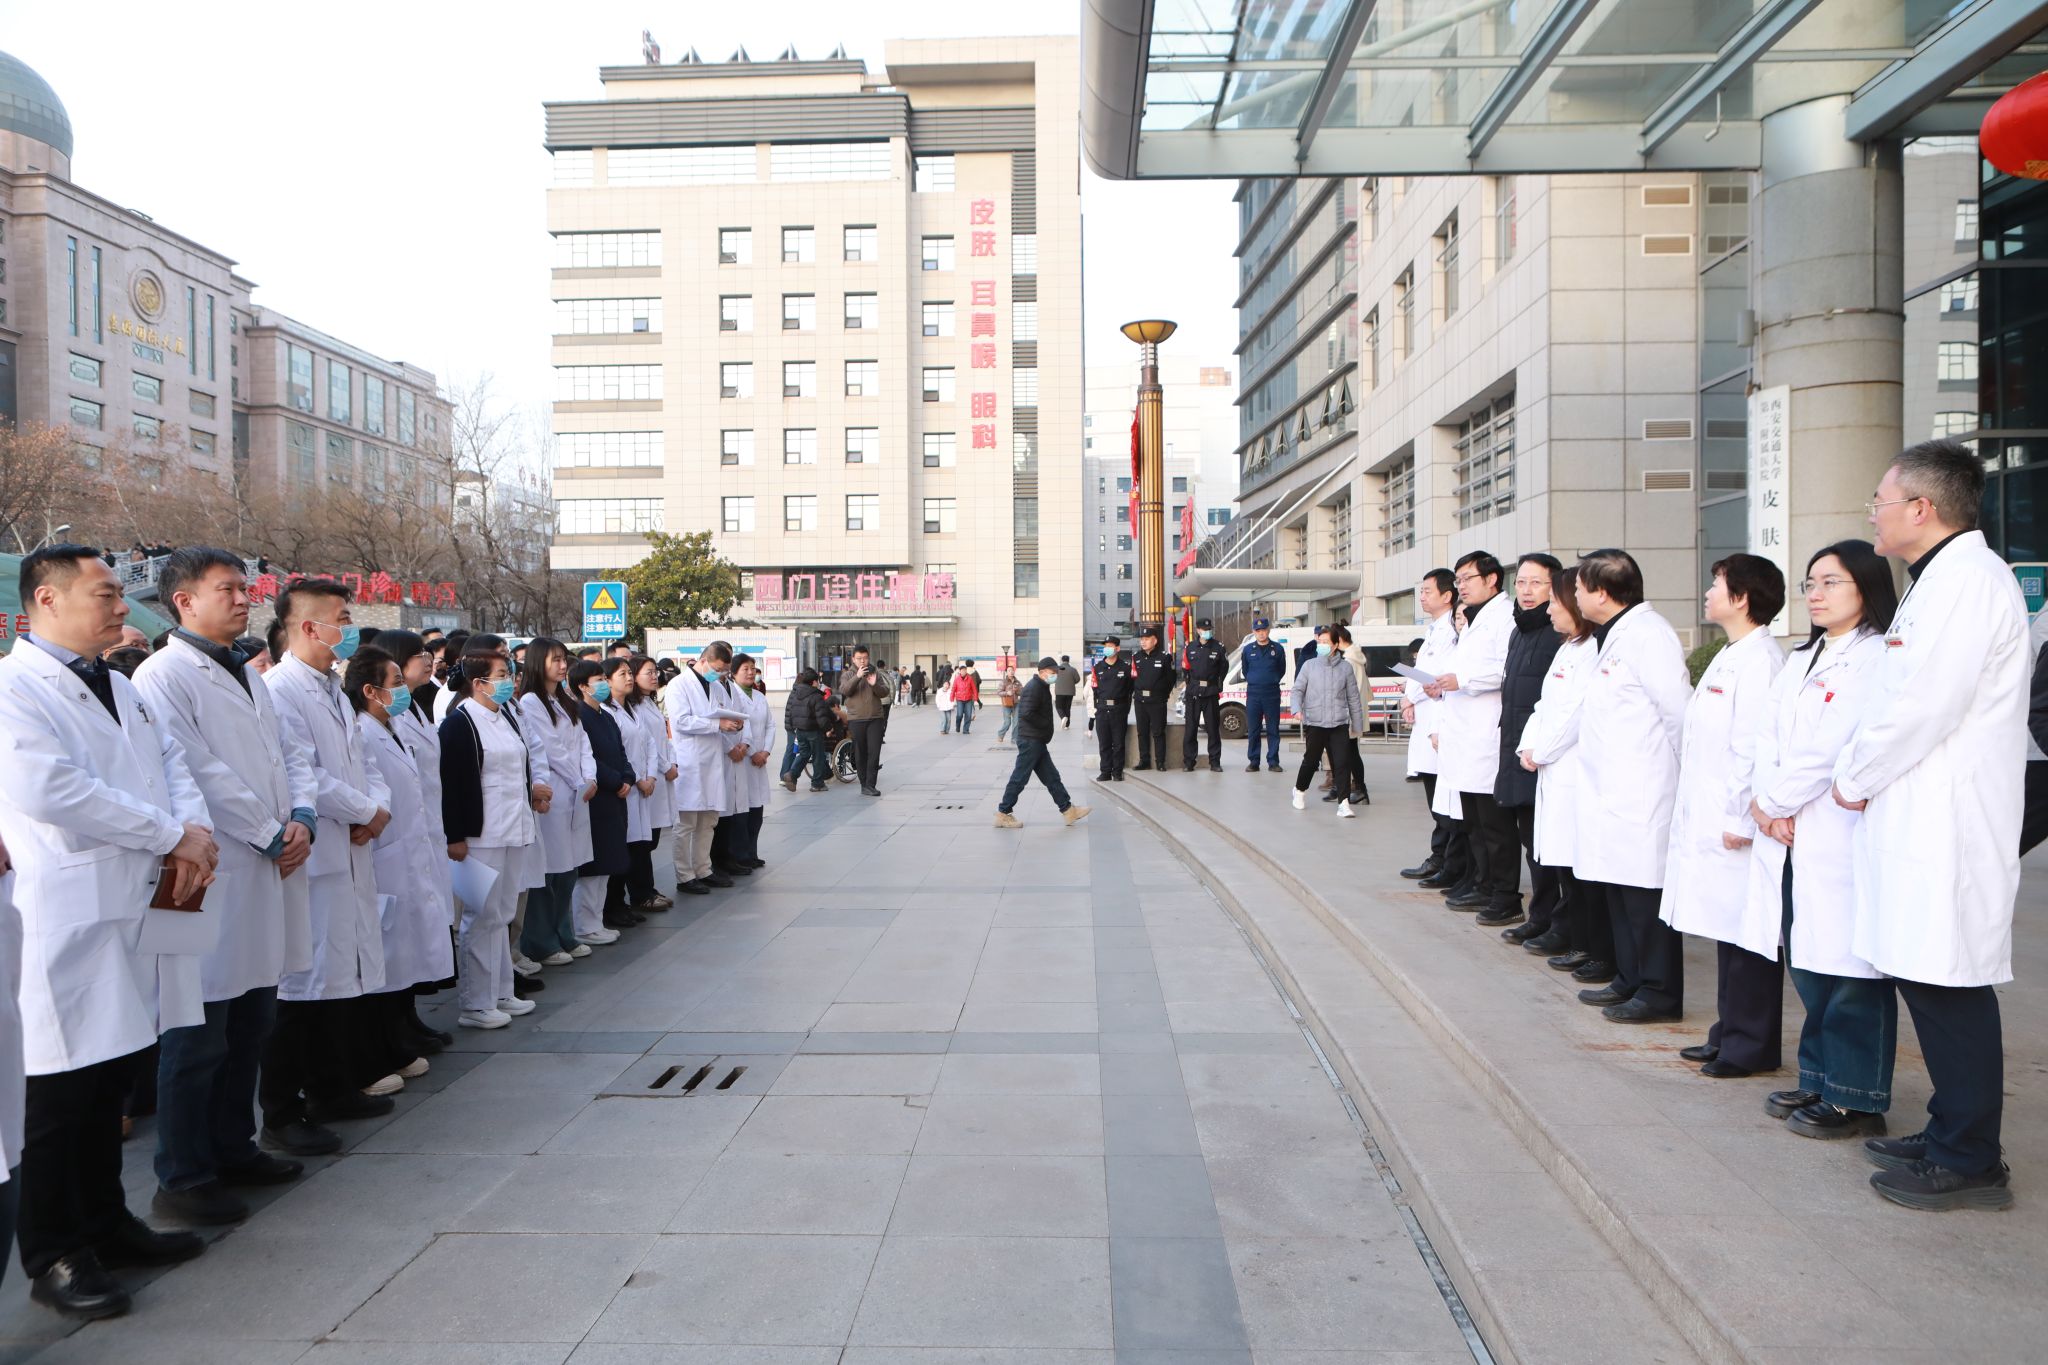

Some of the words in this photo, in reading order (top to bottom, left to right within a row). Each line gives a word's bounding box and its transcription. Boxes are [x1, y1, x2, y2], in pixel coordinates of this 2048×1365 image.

[970, 198, 996, 257] 皮肤
[970, 280, 997, 369] 耳鼻喉
[970, 392, 998, 450] 眼科
[1771, 399, 1782, 480] 西安交通大学
[755, 573, 953, 601] 西门诊住院楼
[756, 603, 779, 612] WEST
[586, 614, 622, 623] 注意行人
[586, 623, 623, 633] 注意车辆
